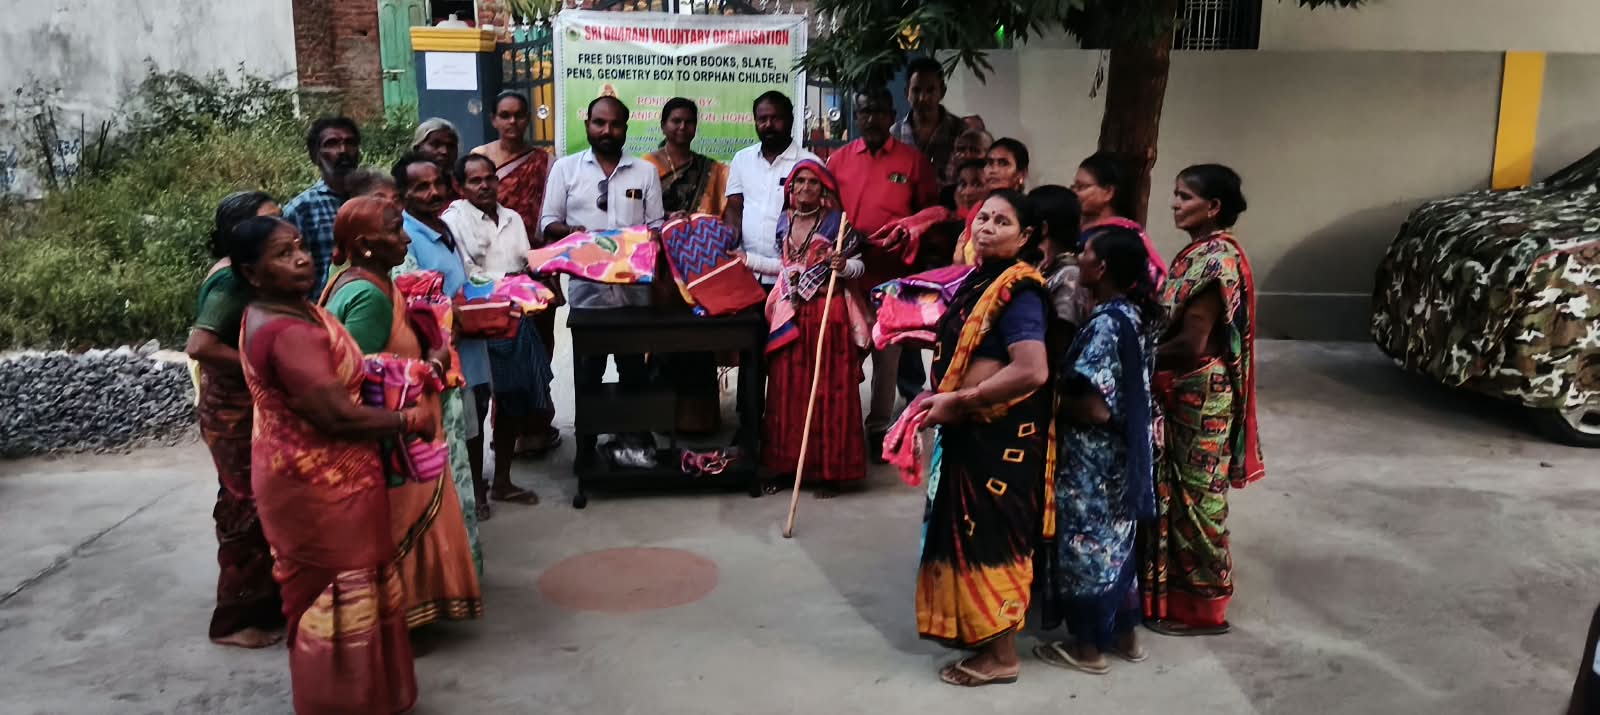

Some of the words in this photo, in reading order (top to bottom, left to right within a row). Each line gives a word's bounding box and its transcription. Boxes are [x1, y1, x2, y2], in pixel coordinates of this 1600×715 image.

[651, 27, 710, 45] VOLUNTARY
[713, 29, 789, 46] ORGANISATION
[578, 53, 603, 64] FREE
[605, 54, 674, 65] DISTRIBUTION
[676, 55, 697, 66] FOR
[700, 56, 739, 70] BOOKS,
[742, 57, 777, 71] SLATE,
[566, 68, 595, 81] PENS,
[597, 69, 651, 80] GEOMETRY
[653, 70, 674, 81] BOX
[676, 70, 690, 82] TO
[693, 71, 735, 83] ORPHAN
[738, 72, 789, 83] CHILDREN
